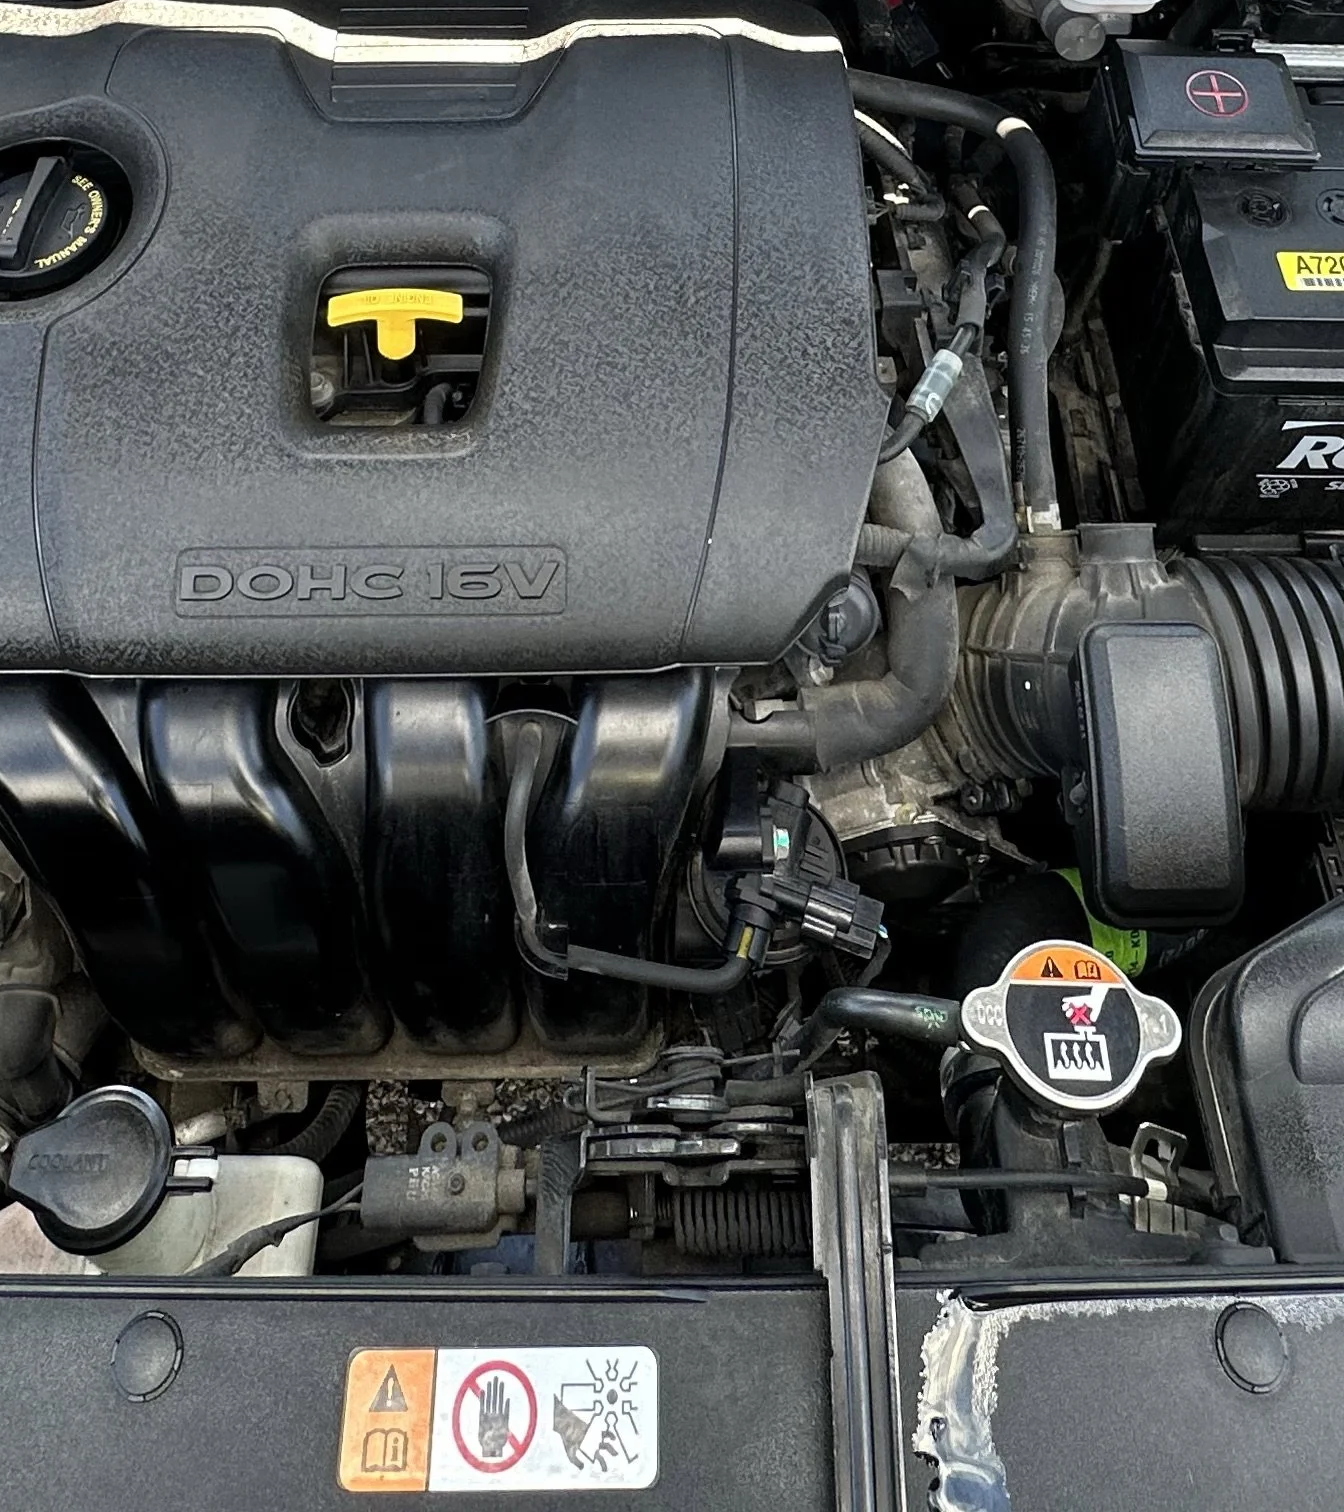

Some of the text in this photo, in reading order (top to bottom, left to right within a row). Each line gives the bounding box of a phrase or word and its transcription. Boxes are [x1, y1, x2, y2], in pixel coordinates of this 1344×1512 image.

[71, 174, 94, 191] SEE
[34, 235, 88, 268] MANUAL
[179, 562, 561, 601] DOHC 16V
[28, 1153, 110, 1170] COOLANT
